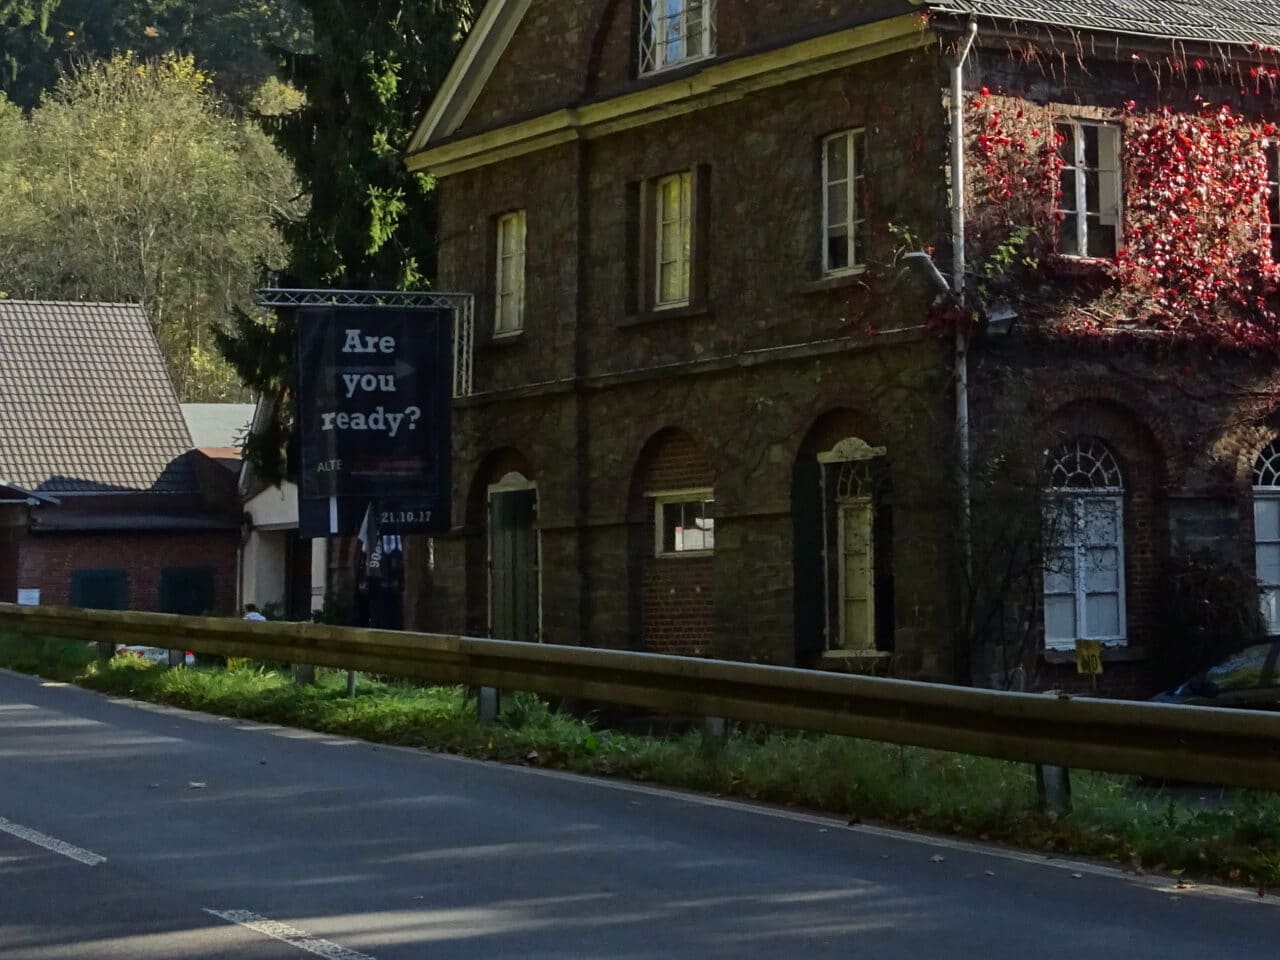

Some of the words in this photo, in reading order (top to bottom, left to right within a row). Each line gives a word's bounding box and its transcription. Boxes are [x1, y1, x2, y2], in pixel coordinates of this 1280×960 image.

[342, 329, 396, 354] Are
[342, 373, 396, 398] you
[321, 406, 422, 437] ready?
[317, 459, 343, 473] ALTE
[381, 510, 432, 523] 21.10.17
